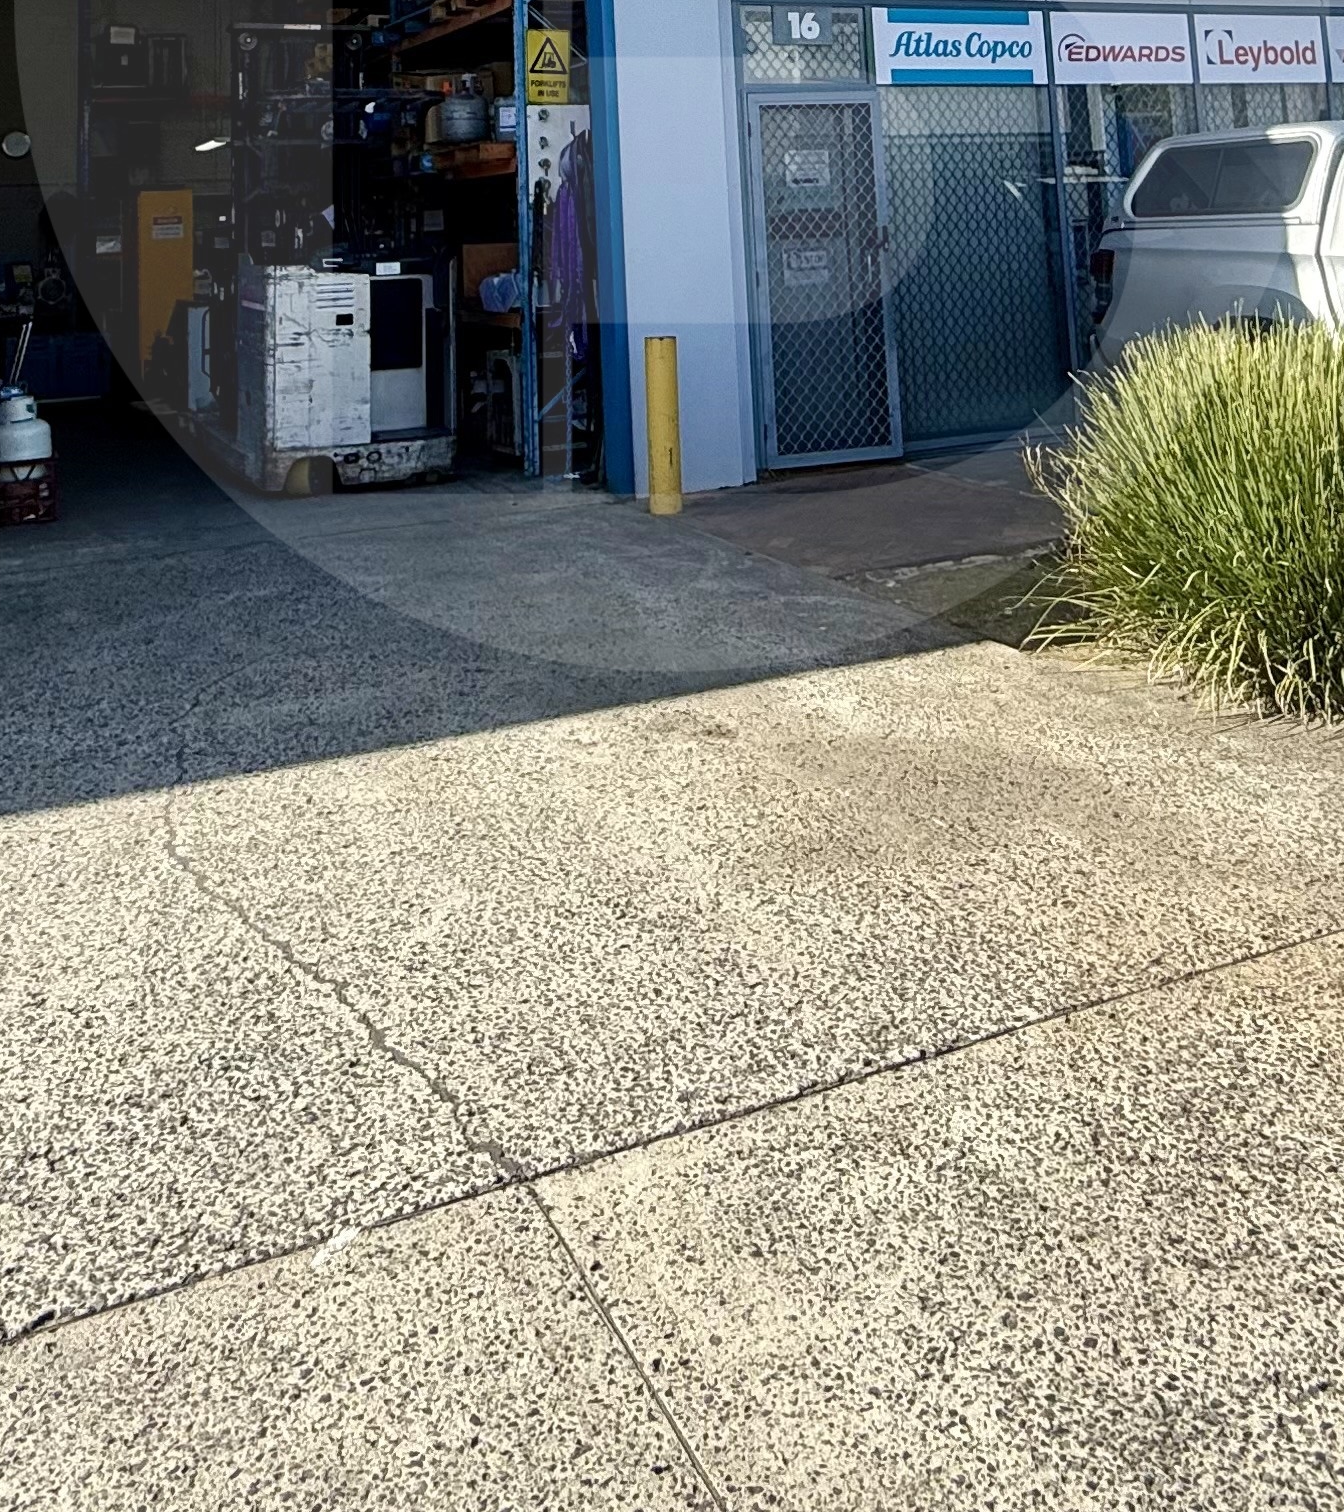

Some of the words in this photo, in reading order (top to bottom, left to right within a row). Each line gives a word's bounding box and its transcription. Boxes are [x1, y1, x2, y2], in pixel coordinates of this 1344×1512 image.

[788, 12, 820, 39] 16
[889, 31, 961, 58] Atlas
[965, 32, 1033, 63] Copco
[1066, 44, 1186, 63] EDWARDS
[1217, 39, 1317, 72] Leybold
